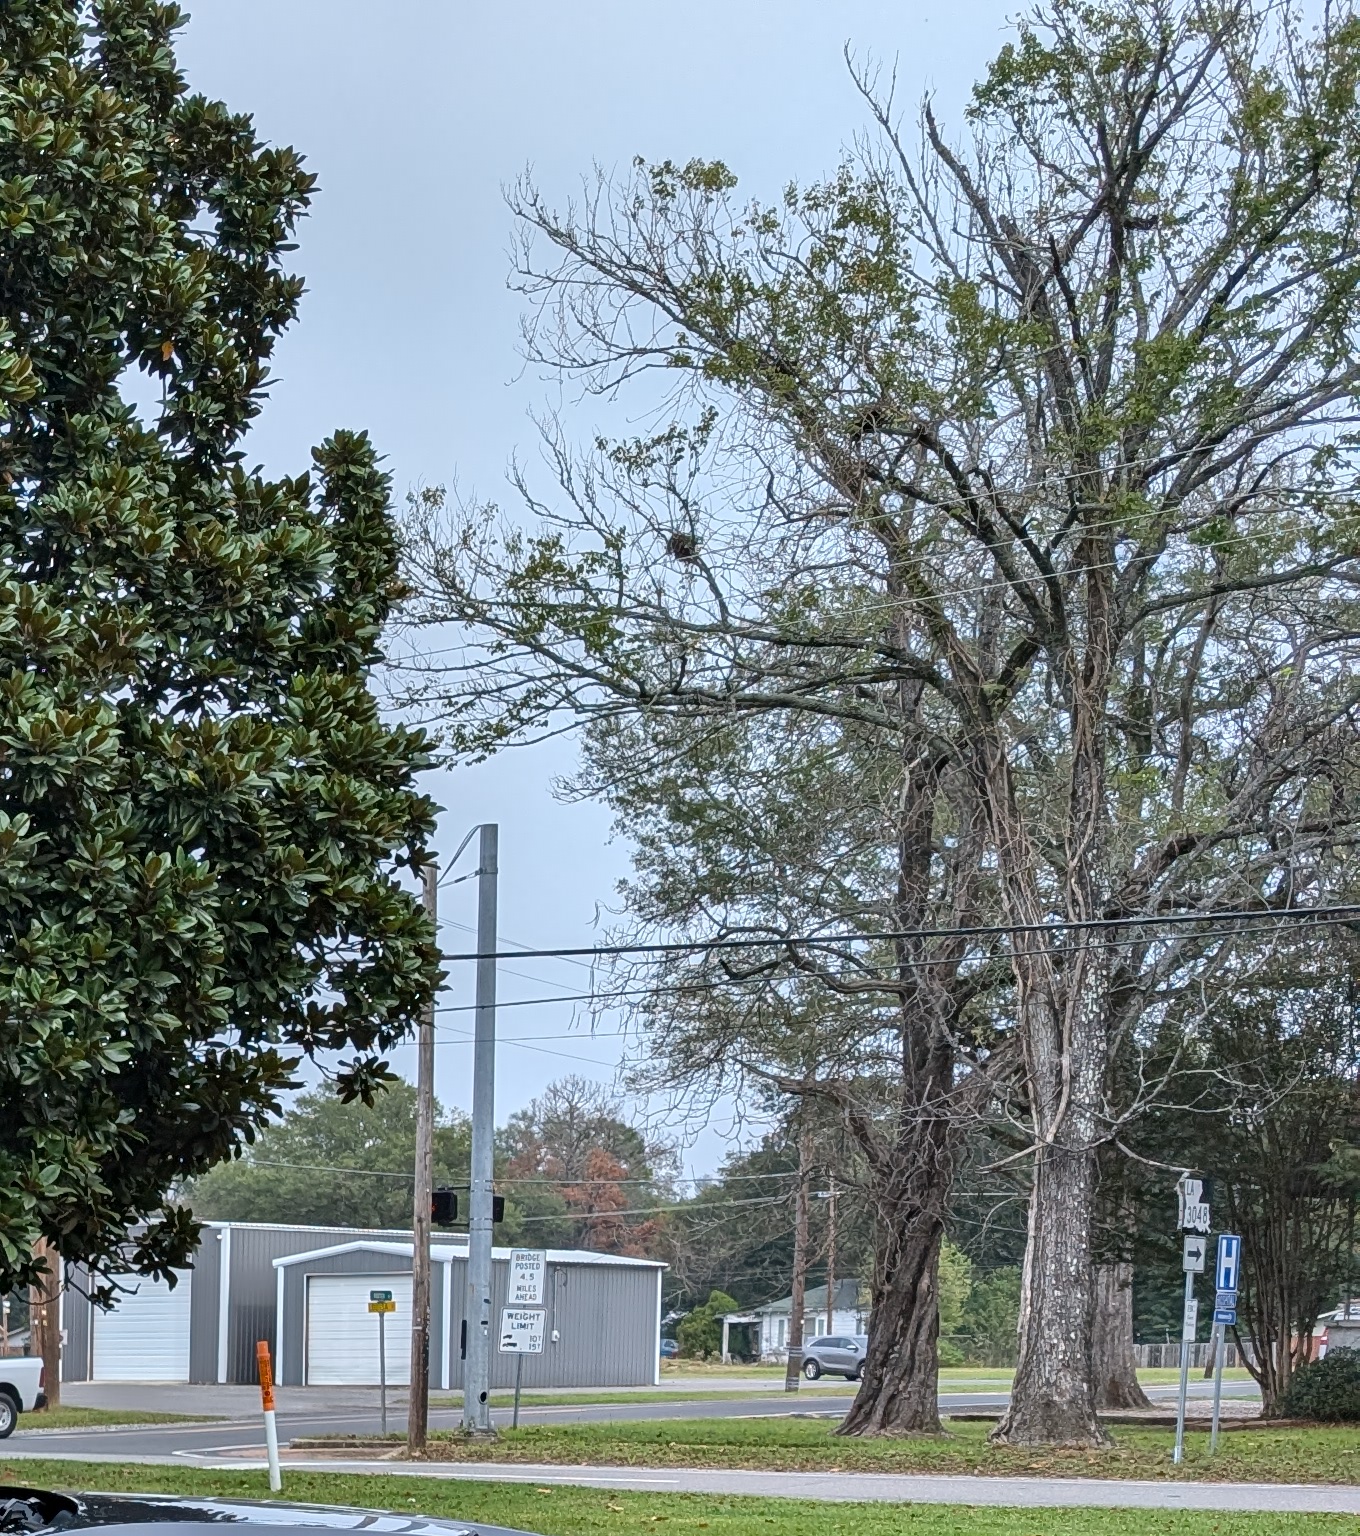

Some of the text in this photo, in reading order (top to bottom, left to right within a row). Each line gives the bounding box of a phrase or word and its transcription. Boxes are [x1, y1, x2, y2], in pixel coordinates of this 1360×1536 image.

[1186, 1205, 1208, 1225] 3048
[515, 1253, 540, 1261] BRIDGE
[515, 1262, 541, 1270] POSTED
[1219, 1239, 1238, 1288] H
[520, 1273, 535, 1281] 4.5
[516, 1285, 537, 1293] MILES
[515, 1293, 537, 1301] AHEAD
[507, 1312, 541, 1321] WEIGHT
[511, 1322, 535, 1330] LIMIT
